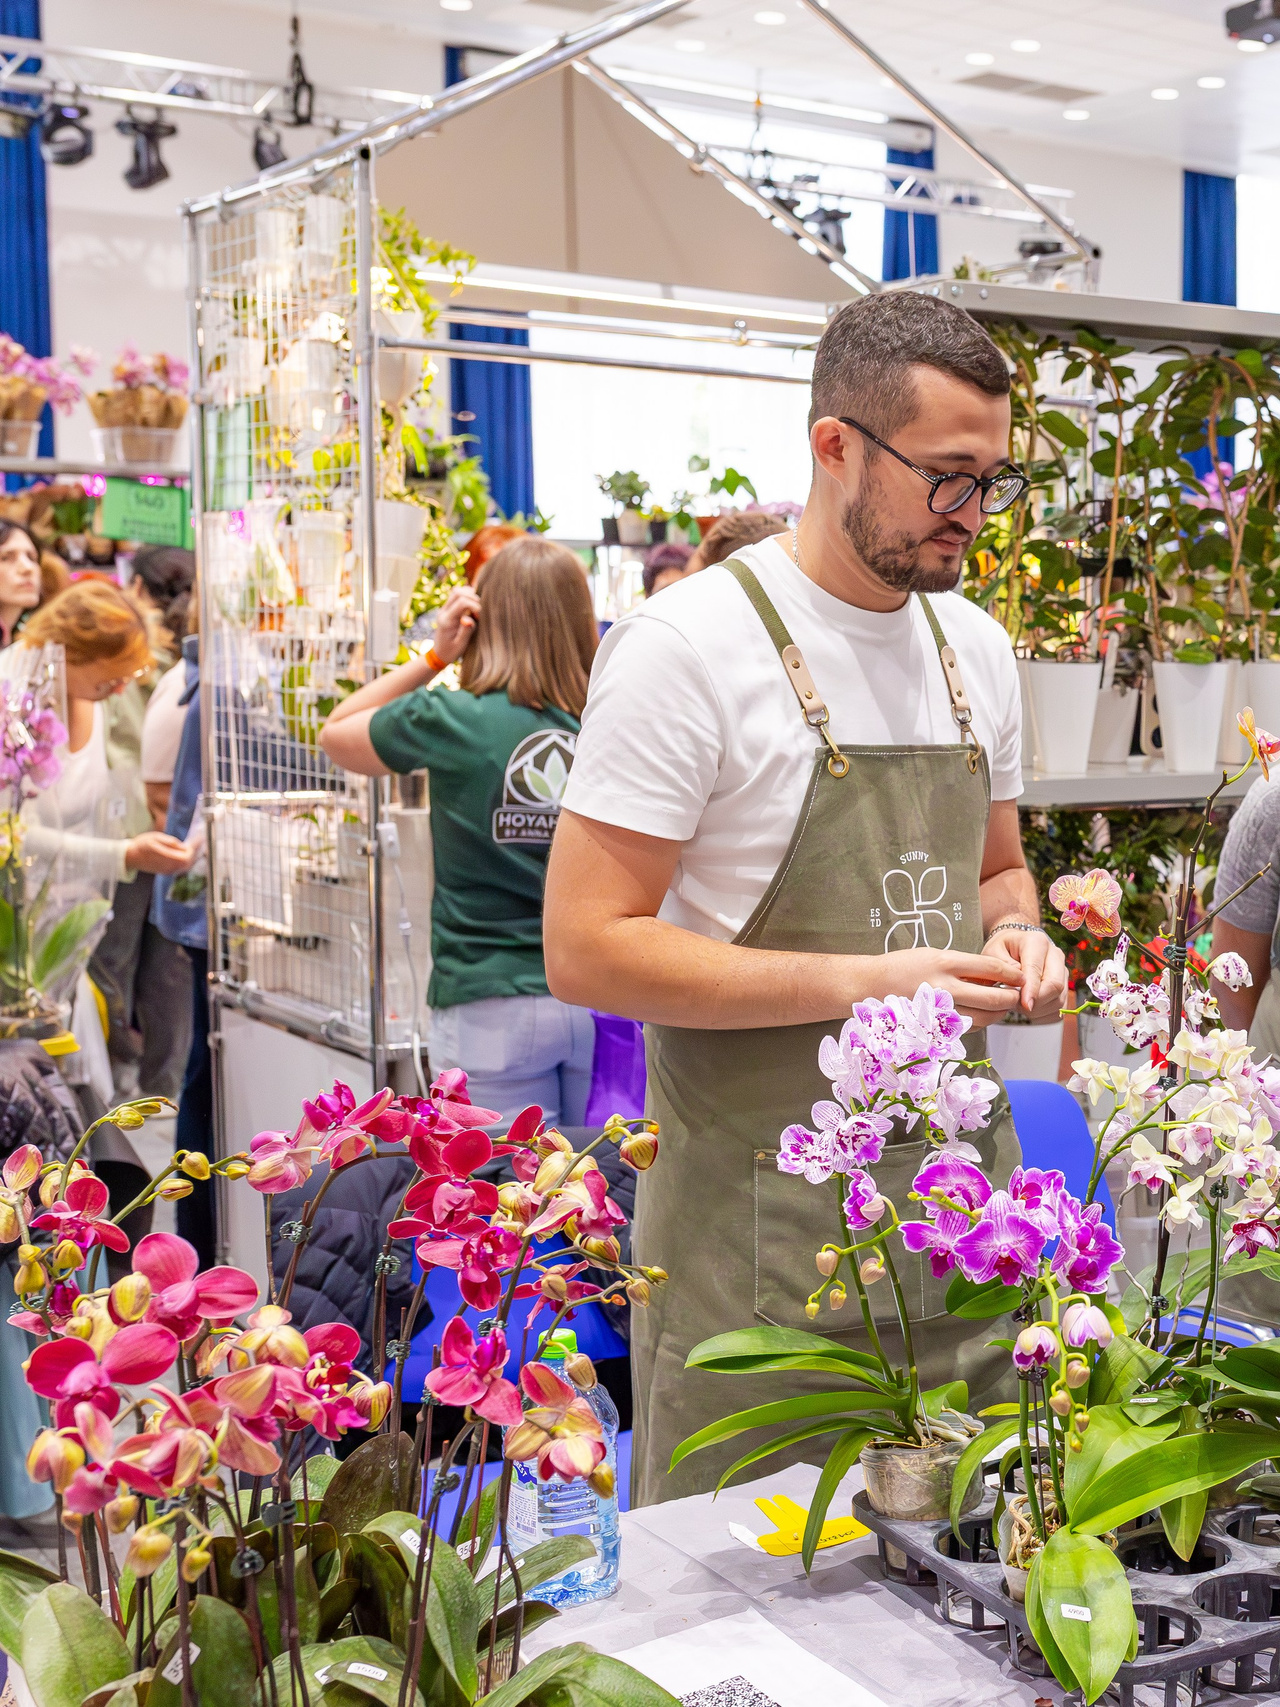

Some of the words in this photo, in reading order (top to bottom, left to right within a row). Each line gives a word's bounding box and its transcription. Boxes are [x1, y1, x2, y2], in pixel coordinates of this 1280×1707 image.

[900, 850, 929, 864] SUNNY
[953, 902, 962, 911] 20
[870, 908, 880, 917] ES
[954, 912, 962, 921] 22
[870, 919, 881, 927] TD
